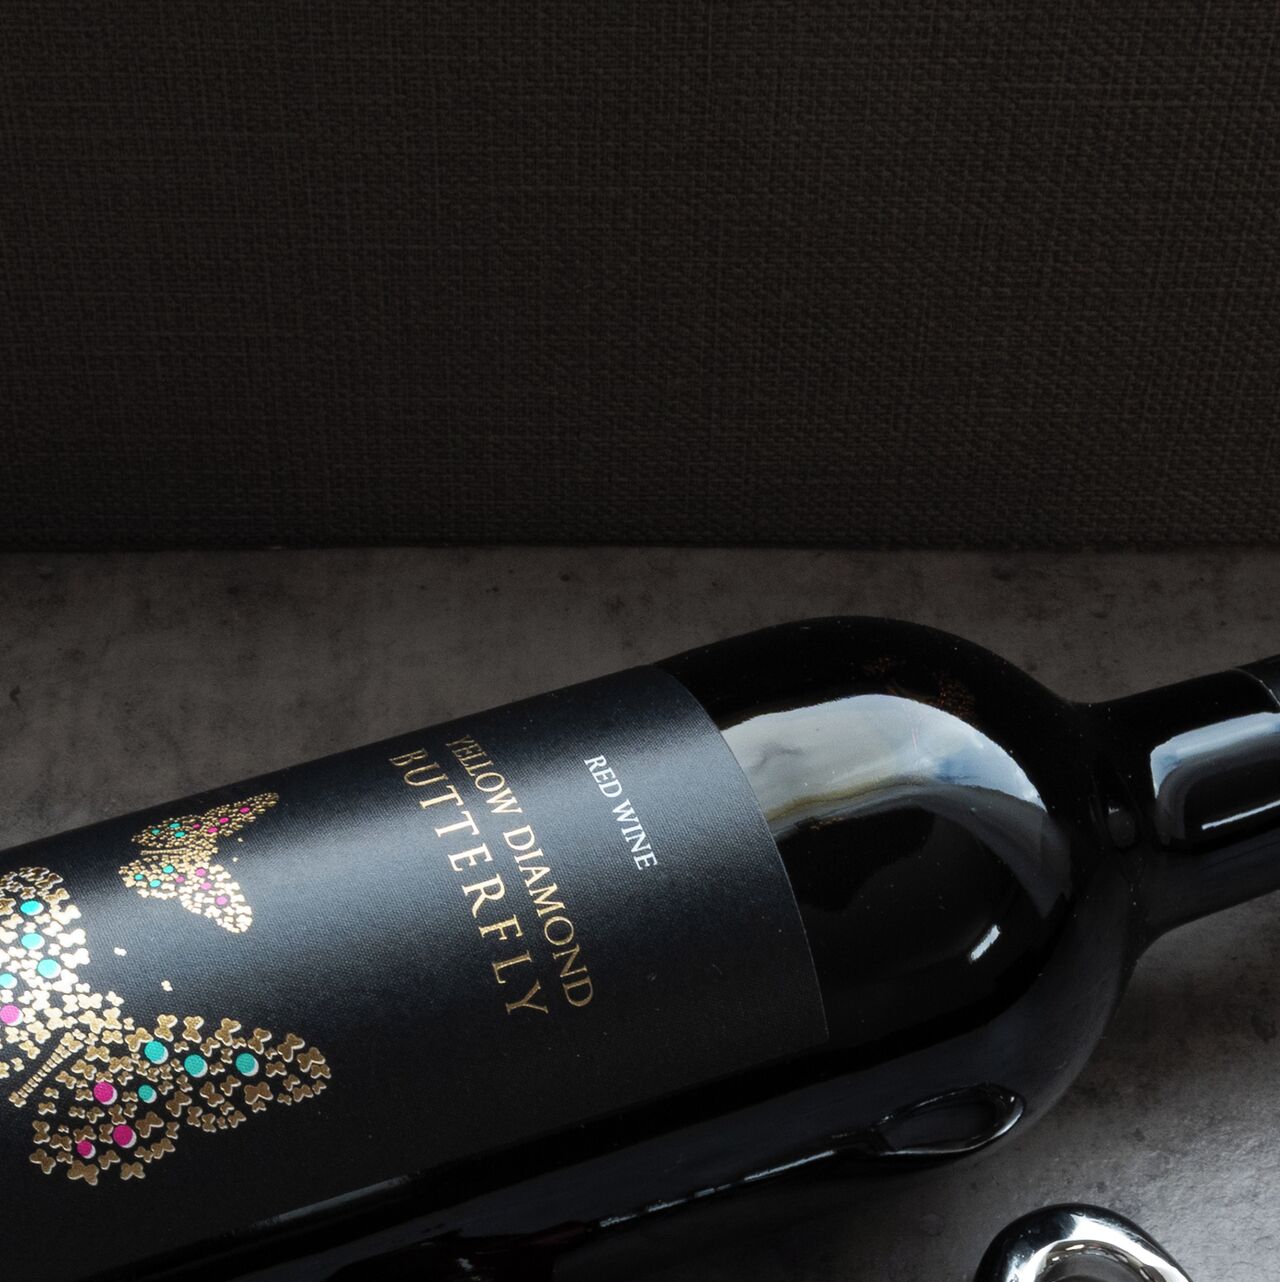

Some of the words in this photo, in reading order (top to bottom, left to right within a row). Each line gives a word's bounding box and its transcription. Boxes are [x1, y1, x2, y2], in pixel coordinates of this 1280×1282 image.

[388, 747, 549, 1016] BUTTERFLY
[445, 736, 523, 814] YELLOW
[503, 825, 594, 1008] DIAMOND
[583, 754, 623, 798] RED
[612, 798, 658, 871] WINE
